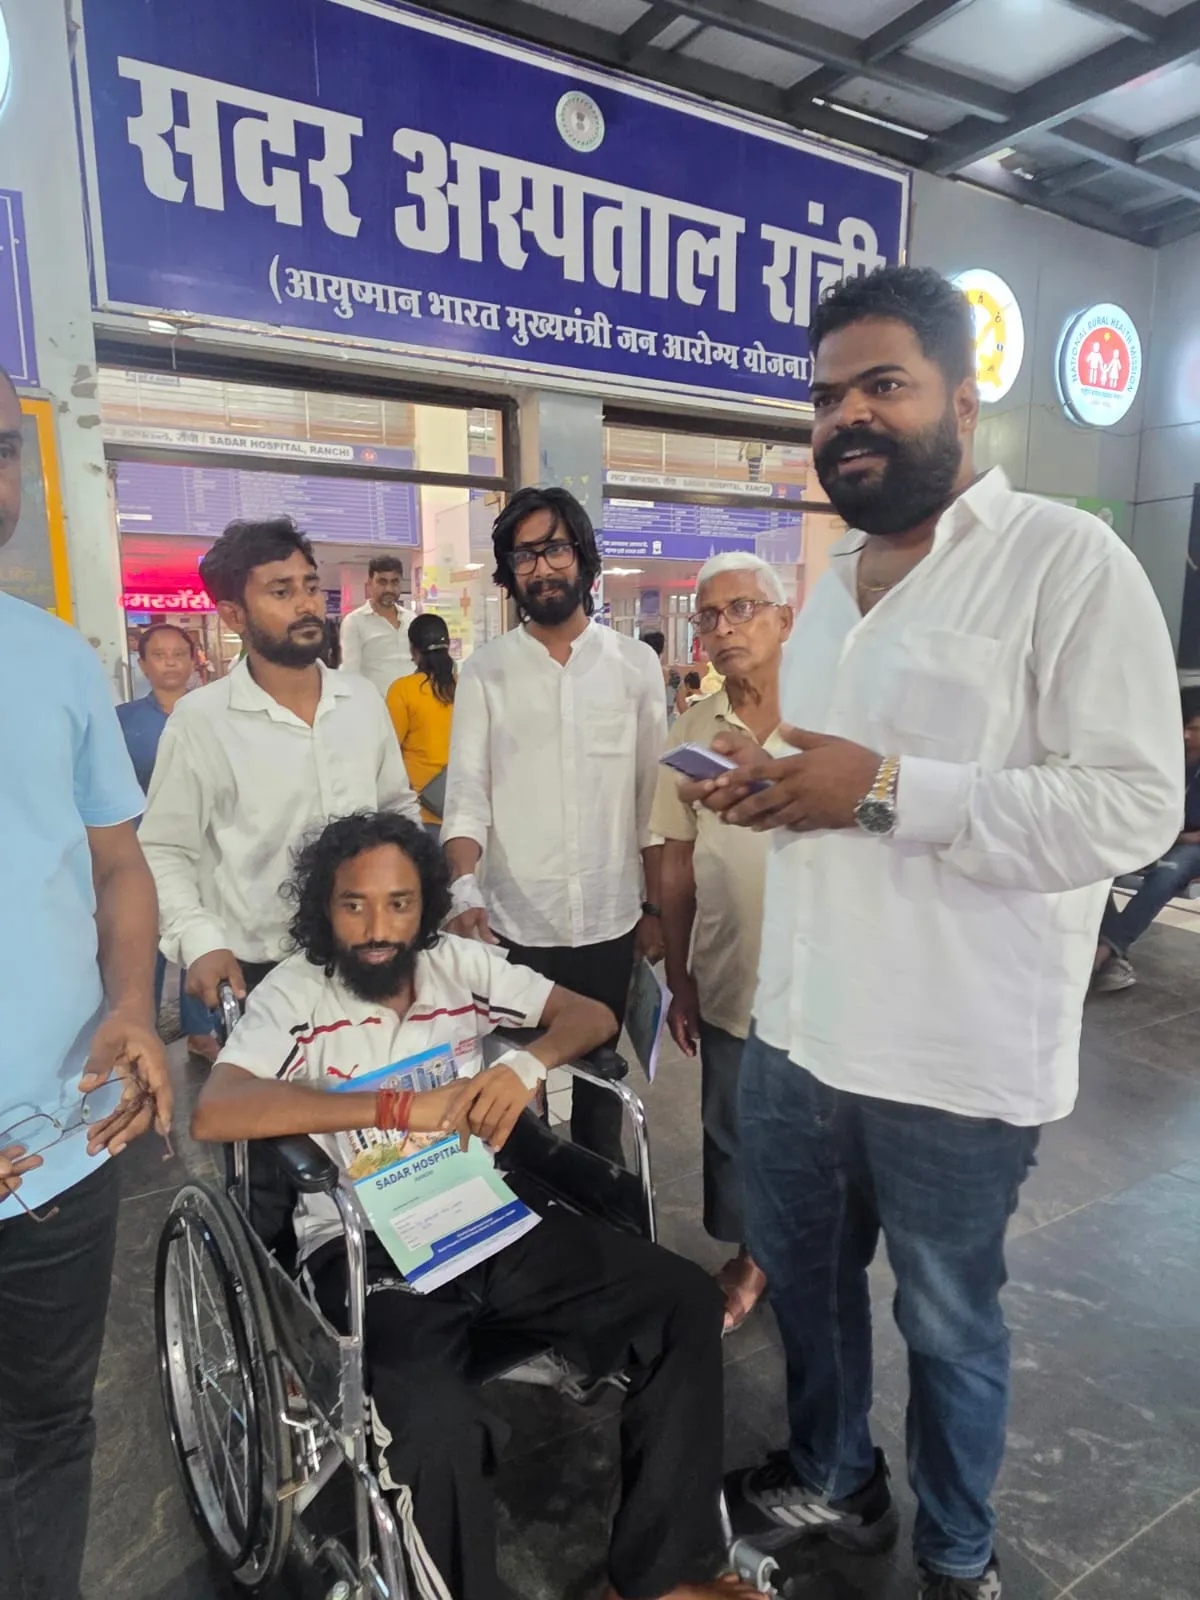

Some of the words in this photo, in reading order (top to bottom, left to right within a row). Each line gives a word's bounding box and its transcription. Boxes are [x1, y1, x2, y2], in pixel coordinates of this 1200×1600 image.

[117, 55, 363, 238] सदर
[393, 127, 745, 312] अस्पताल
[427, 291, 501, 331] भारत
[505, 306, 613, 349] मुख्यमंत्री
[616, 325, 658, 357] जन
[662, 330, 740, 370] आरोग्य
[1071, 328, 1086, 383] NATIONAL
[1087, 316, 1110, 329] RURAL
[1111, 318, 1133, 345] HEALTH
[1127, 345, 1139, 393] MISSION
[208, 435, 248, 449] SADAR
[310, 446, 351, 458] RANCHI
[375, 1165, 412, 1191] SADAR
